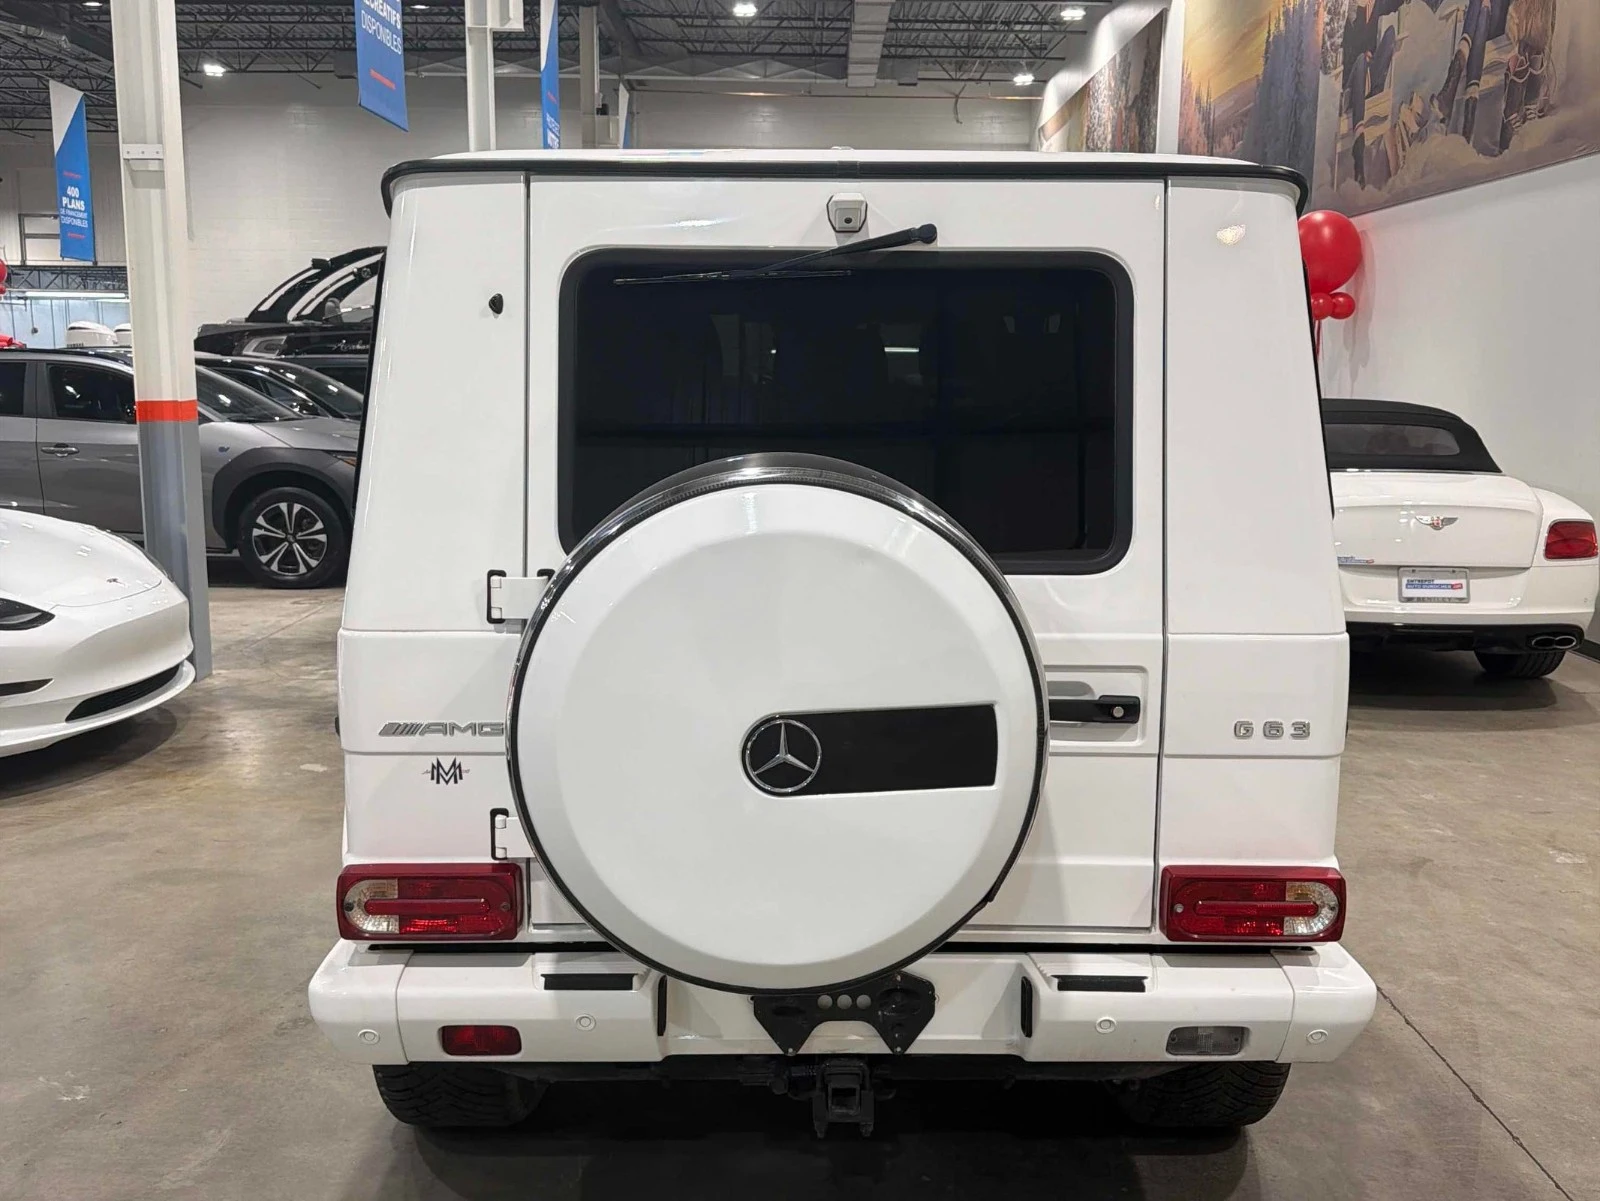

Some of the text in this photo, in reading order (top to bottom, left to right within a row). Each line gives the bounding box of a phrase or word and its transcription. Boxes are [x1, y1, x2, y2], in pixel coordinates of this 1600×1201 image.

[361, 10, 402, 55] DISPONIBLES
[66, 185, 80, 198] 400
[62, 196, 86, 211] PLANS
[60, 215, 89, 228] DISPONIBLES
